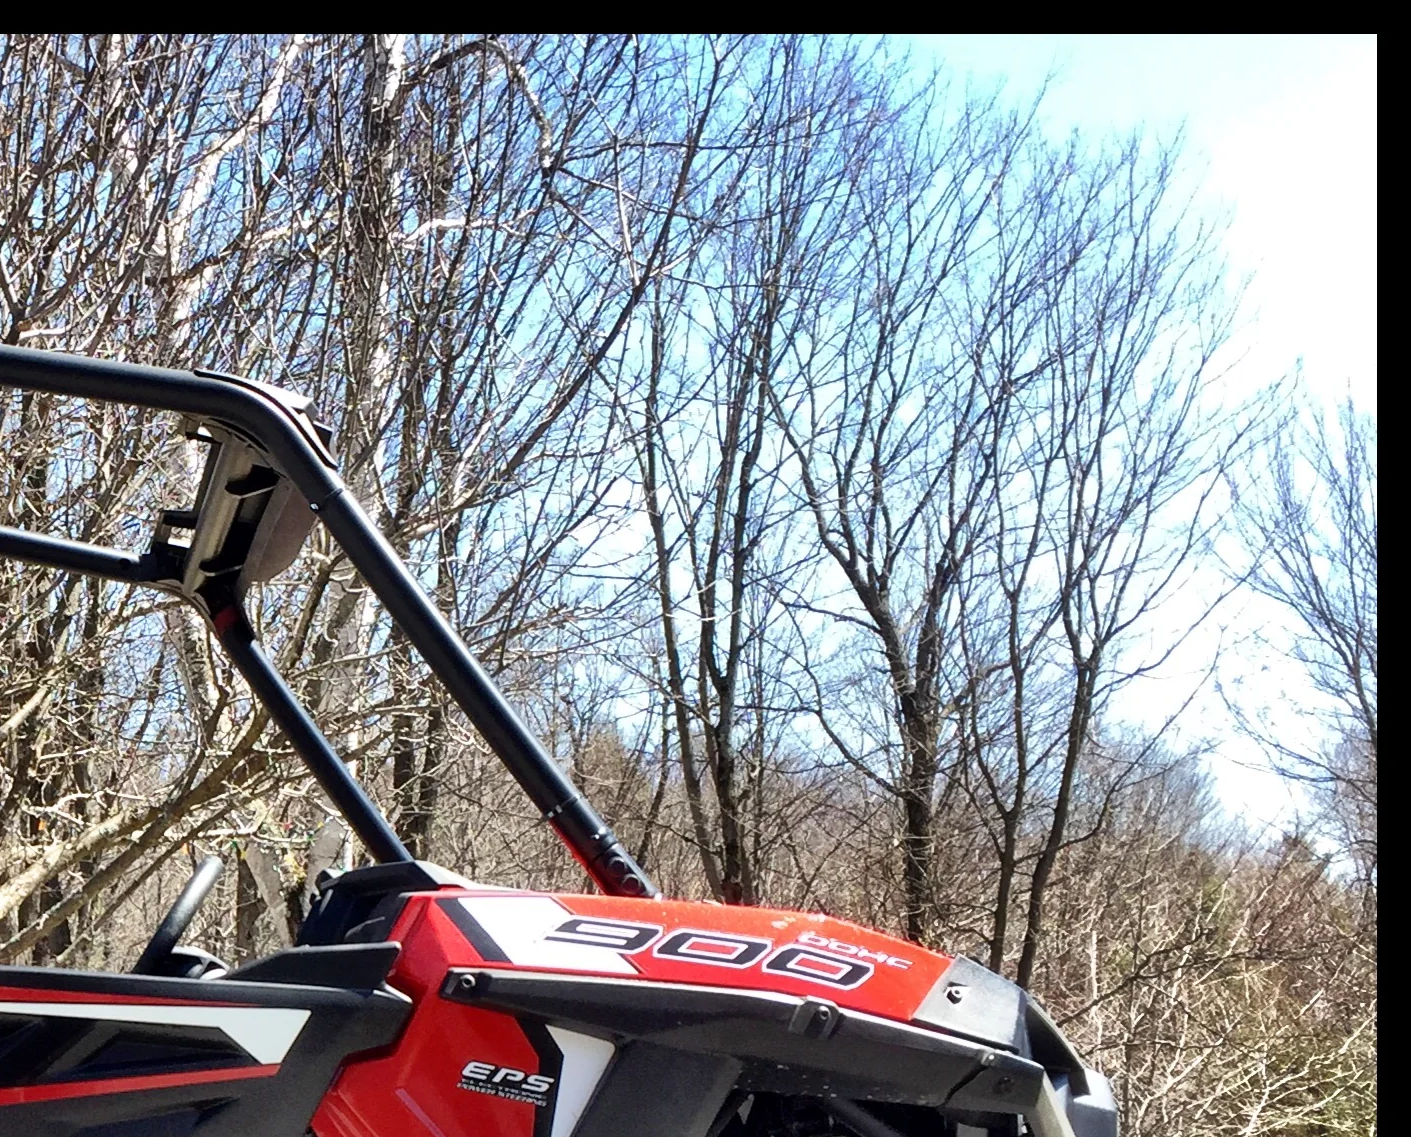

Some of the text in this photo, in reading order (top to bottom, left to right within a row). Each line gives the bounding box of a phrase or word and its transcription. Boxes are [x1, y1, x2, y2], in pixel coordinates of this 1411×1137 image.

[540, 914, 875, 990] 900
[797, 931, 914, 970] DOHC
[461, 1061, 555, 1093] EPS
